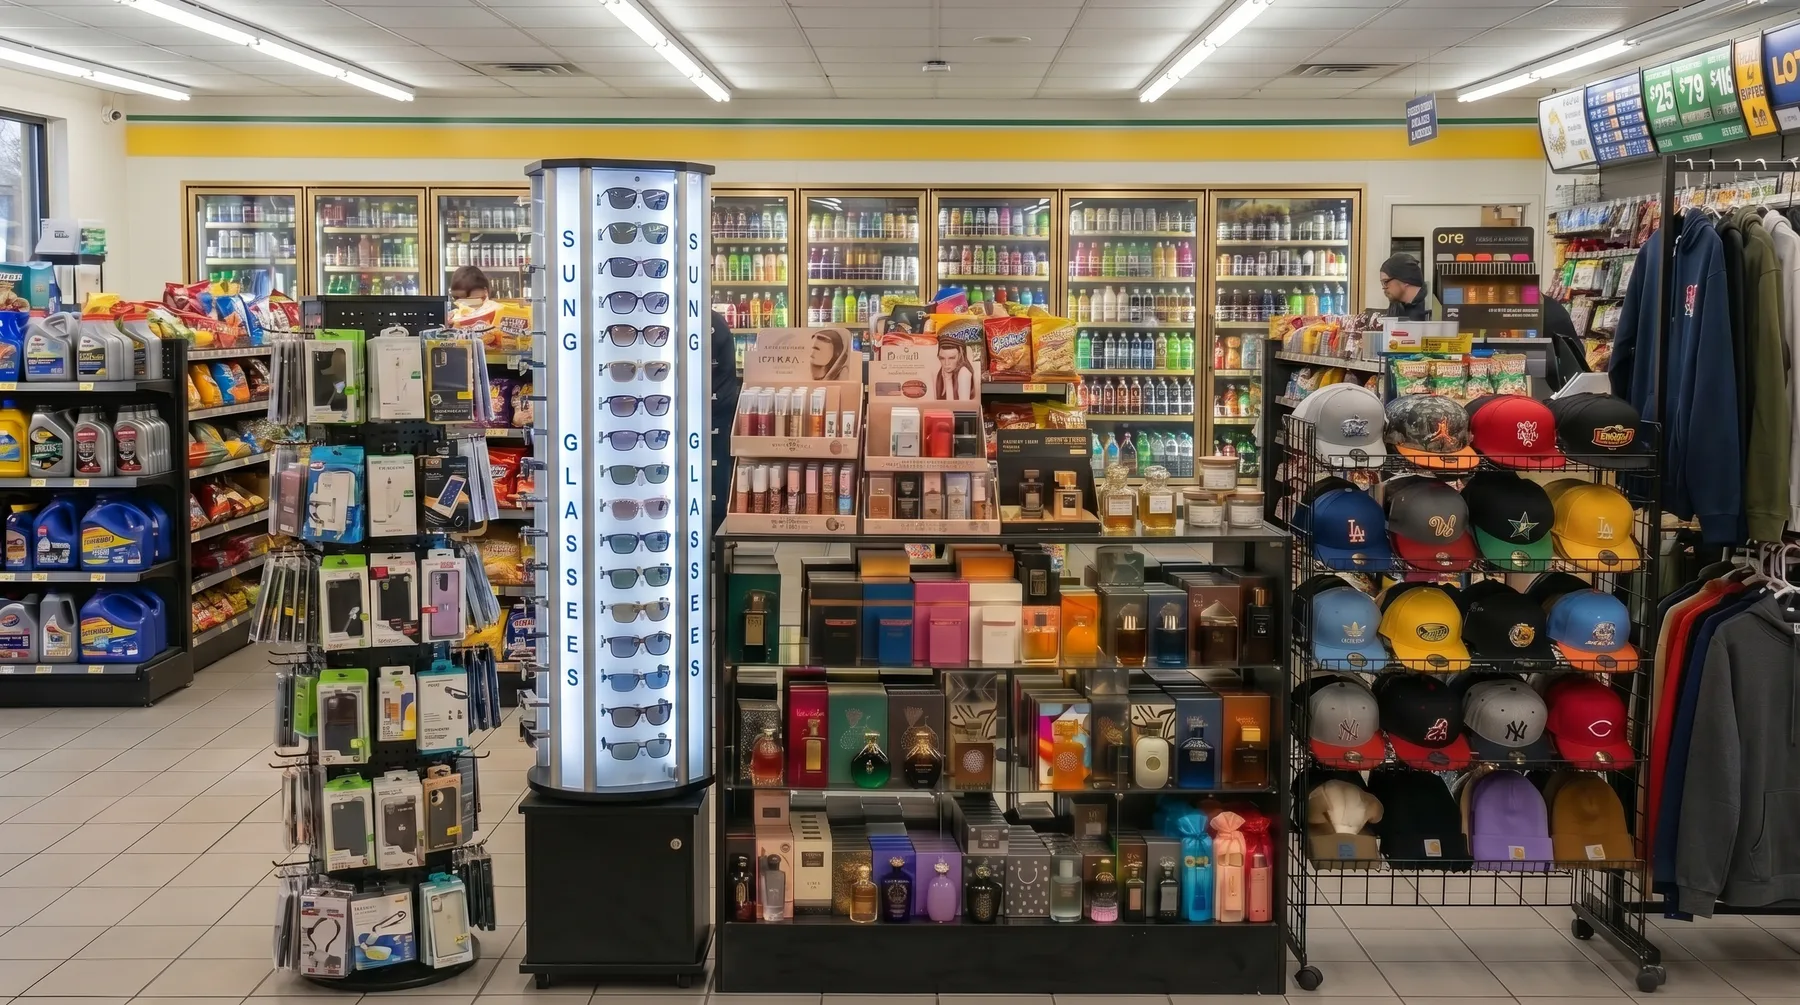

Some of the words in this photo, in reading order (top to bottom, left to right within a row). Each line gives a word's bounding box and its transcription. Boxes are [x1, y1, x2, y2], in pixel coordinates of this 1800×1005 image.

[1649, 81, 1675, 114] $25
[1679, 73, 1705, 106] $79
[1347, 519, 1366, 543] LA
[1596, 516, 1614, 540] LA
[1338, 717, 1360, 742] NY
[1504, 720, 1528, 742] NY
